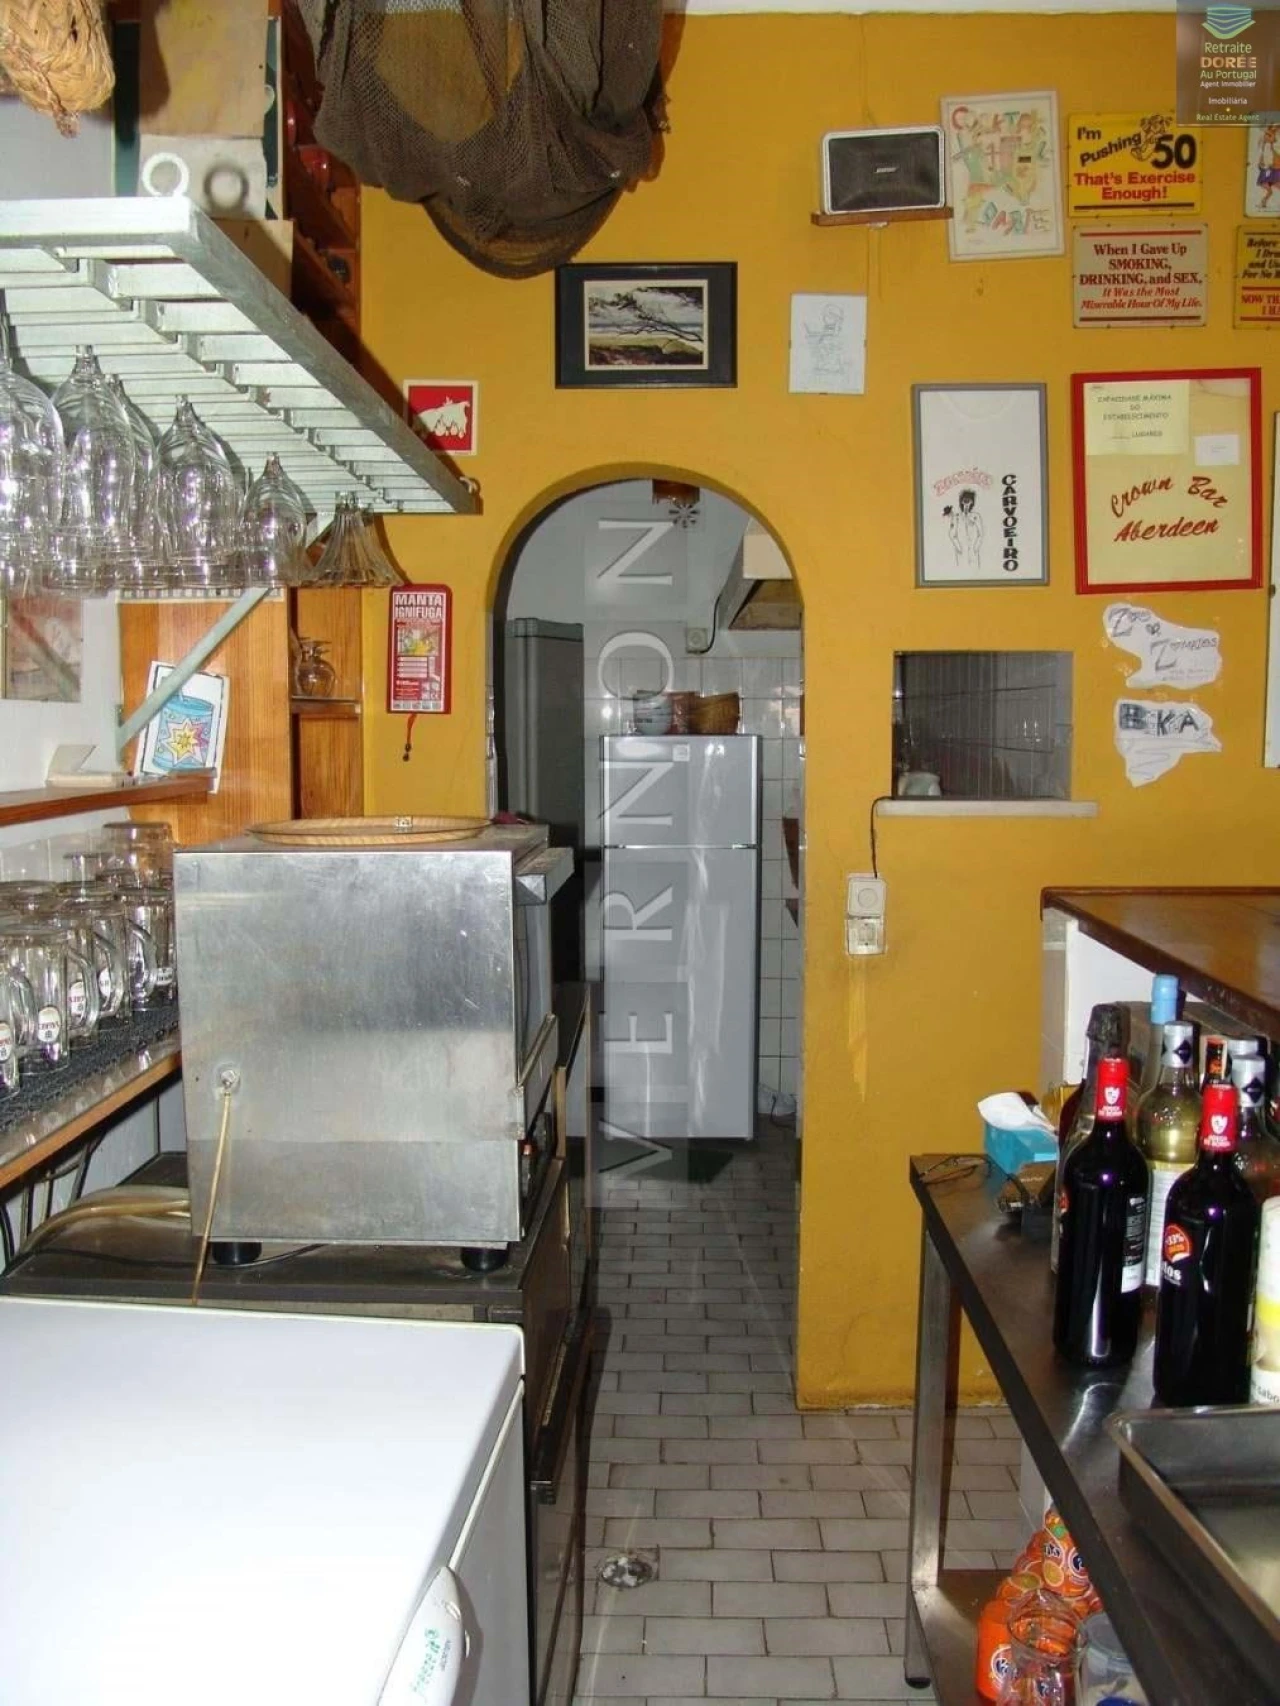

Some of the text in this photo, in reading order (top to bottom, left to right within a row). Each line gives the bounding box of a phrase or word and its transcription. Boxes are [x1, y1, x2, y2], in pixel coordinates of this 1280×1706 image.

[1077, 125, 1102, 141] I'm
[1079, 132, 1197, 169] Pushing 50
[1074, 170, 1196, 186] That's Exercise
[1102, 186, 1168, 201] Enough!
[1093, 242, 1188, 256] When I Gave Up
[1149, 272, 1171, 285] and
[1112, 287, 1134, 297] Was
[1137, 286, 1153, 297] the
[1155, 286, 1180, 297] Most
[1241, 294, 1263, 304] NOW
[1081, 298, 1127, 311] Miserable
[1127, 297, 1152, 309] Hour
[1165, 296, 1181, 311] My
[1111, 474, 1230, 518] Crown Bar
[1001, 474, 1019, 573] CARVOEIRO
[1113, 516, 1220, 543] Aberdeen
[395, 594, 443, 606] MANTA
